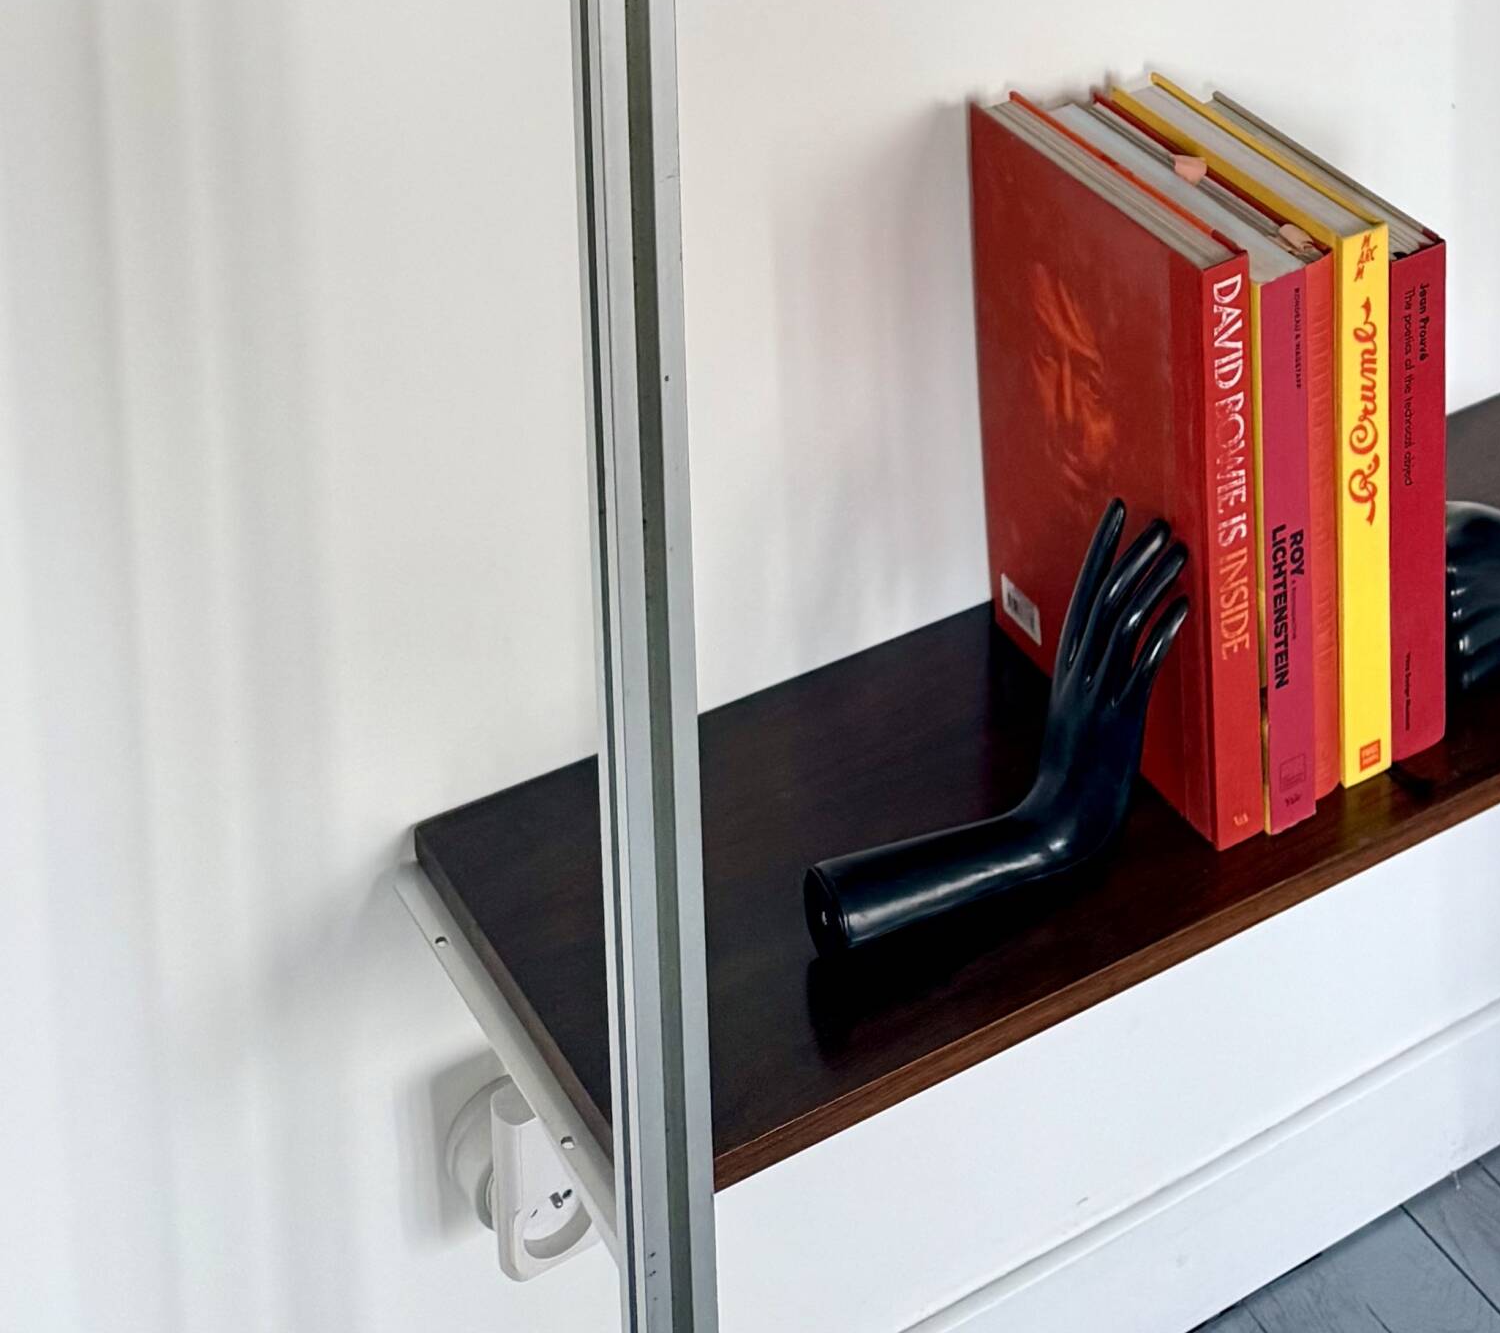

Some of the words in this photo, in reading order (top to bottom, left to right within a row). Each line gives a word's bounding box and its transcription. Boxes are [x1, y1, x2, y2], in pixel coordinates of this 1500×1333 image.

[1404, 286, 1415, 309] The
[1418, 283, 1429, 313] Jean
[1211, 274, 1244, 389] DAVID
[1402, 314, 1413, 354] poetics
[1419, 316, 1429, 360] Prouvé
[1404, 374, 1414, 393] the
[1214, 392, 1247, 513] BOWIE
[1217, 512, 1247, 546] IS
[1289, 529, 1304, 578] ROY
[1218, 545, 1251, 660] INSIDE
[1270, 524, 1290, 689] LICHTENSTEIN
